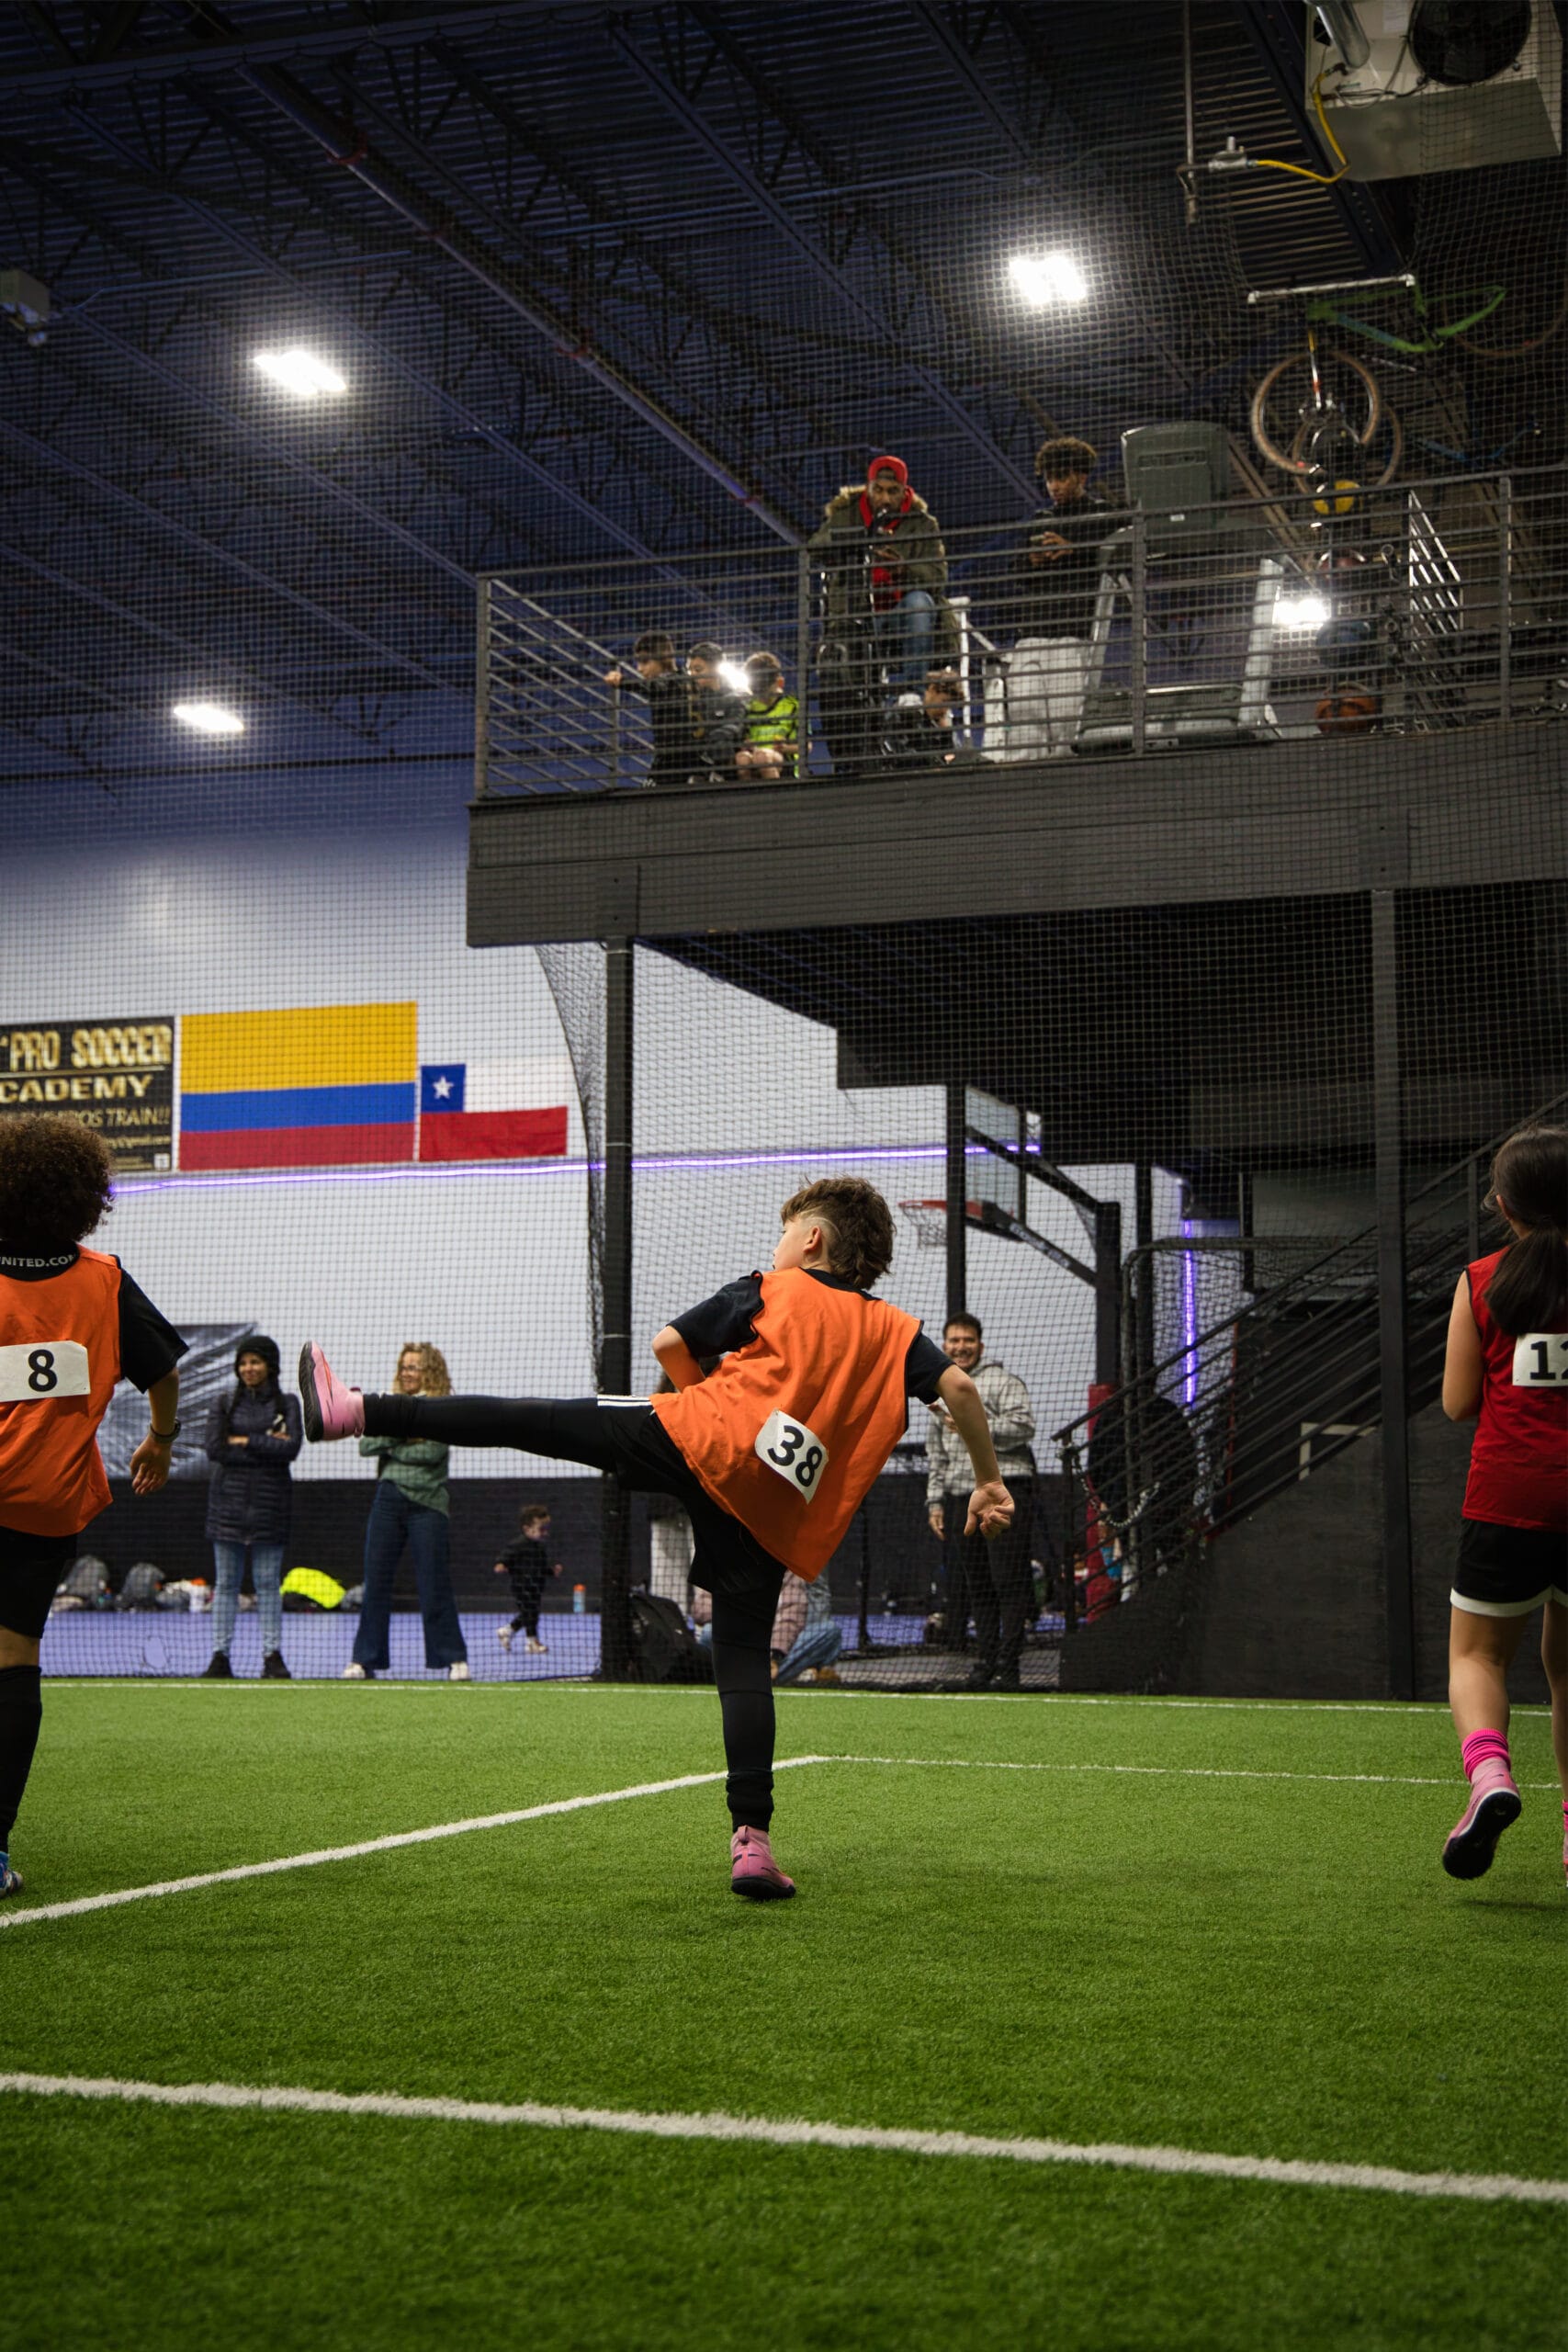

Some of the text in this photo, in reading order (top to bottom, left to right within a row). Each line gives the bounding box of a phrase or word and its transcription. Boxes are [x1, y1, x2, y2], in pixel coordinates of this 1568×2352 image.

[9, 1024, 173, 1072] PRO SOCCER
[28, 1349, 58, 1392] 8
[767, 1425, 822, 1487] 38
